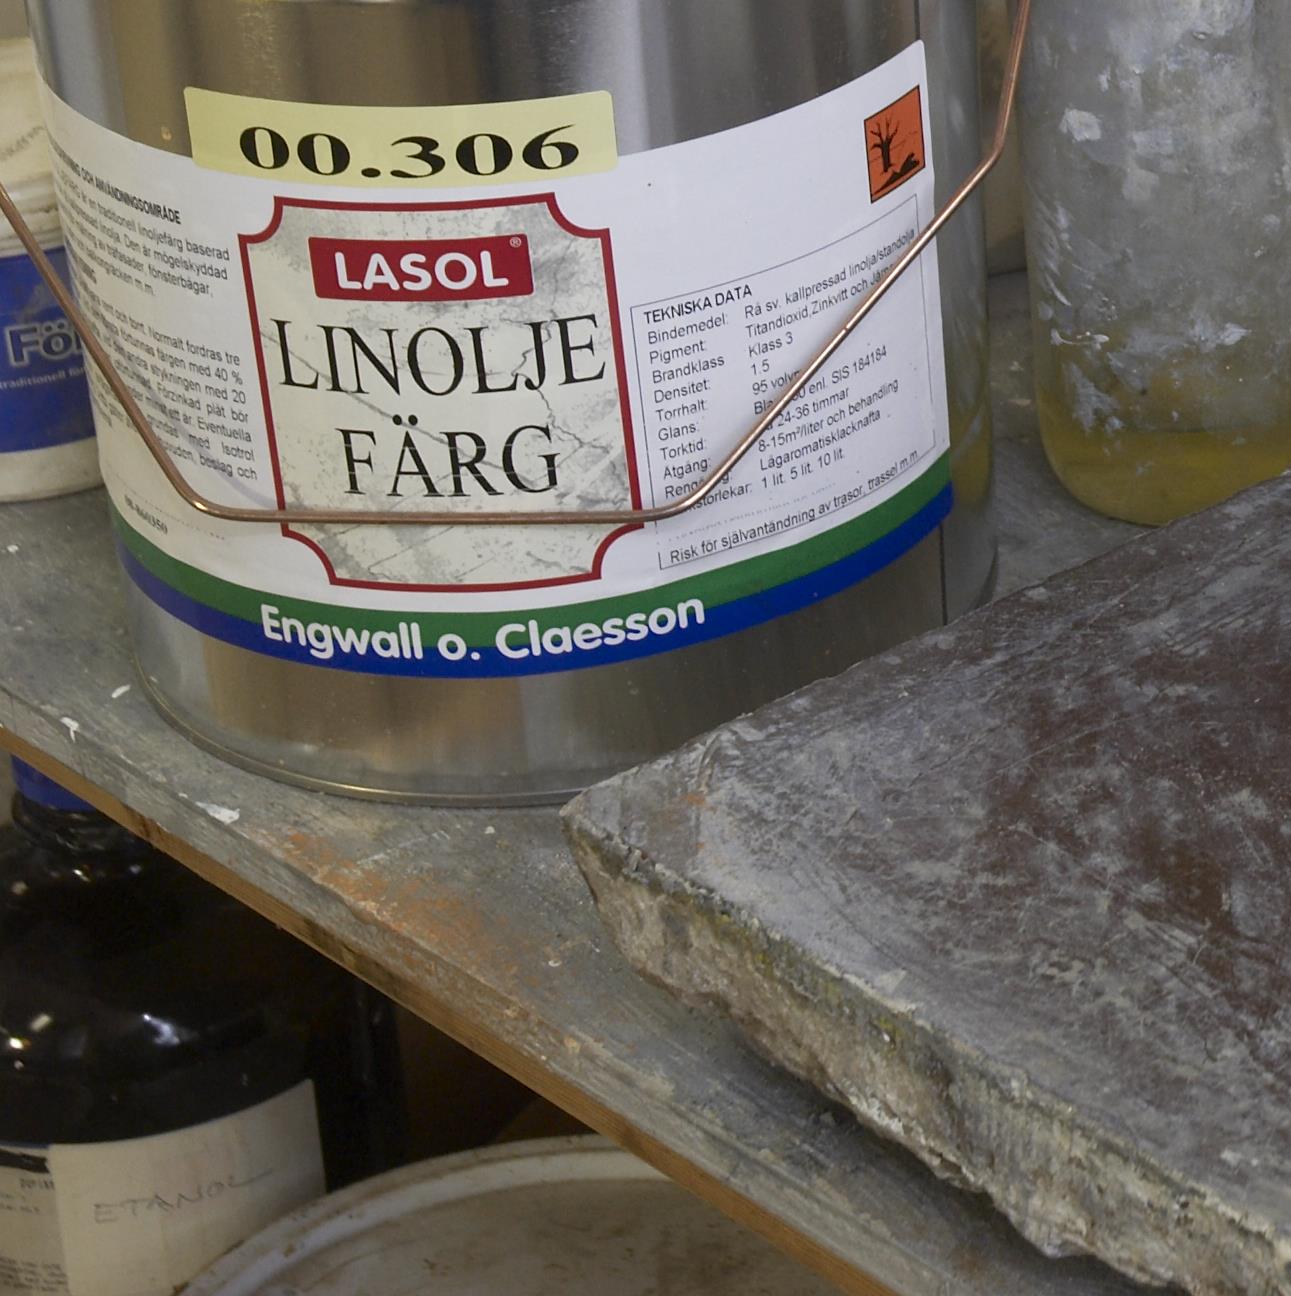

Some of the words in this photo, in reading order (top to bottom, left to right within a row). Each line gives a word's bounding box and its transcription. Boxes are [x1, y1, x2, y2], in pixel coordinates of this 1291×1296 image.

[240, 124, 578, 178] 00.306
[138, 221, 183, 252] linoljefärg
[185, 238, 230, 261] baserad
[153, 250, 227, 280] mögelskyddad
[335, 250, 509, 290] LASOL
[644, 296, 712, 325] TEKNISKA
[715, 284, 752, 306] DATA
[648, 314, 728, 345] Bindemedel:
[785, 271, 847, 305] kallpressad
[650, 340, 706, 364] Pigment:
[850, 282, 868, 297] och
[186, 340, 223, 361] fordras
[225, 349, 240, 366] tre
[189, 359, 211, 378] med
[215, 366, 228, 381] 40
[232, 370, 243, 386] %
[270, 314, 605, 395] LINOLJE
[652, 354, 724, 384] Brandklass
[749, 338, 782, 358] Klass
[786, 333, 793, 345] 3
[205, 384, 228, 403] med
[231, 390, 246, 404] 20
[654, 378, 711, 404] Densitet:
[656, 401, 708, 422] Torrhalt:
[752, 381, 768, 395] 95
[658, 423, 699, 441] Glans:
[831, 366, 849, 384] SIS
[853, 348, 887, 376] 184184
[827, 411, 846, 426] och
[848, 379, 899, 414] behandling
[189, 432, 210, 449] med
[198, 415, 251, 443] Eventuella
[660, 439, 707, 460] Torktid:
[812, 388, 849, 414] timmar
[237, 467, 257, 480] och
[336, 414, 560, 497] FÄRG
[762, 477, 767, 490] 1
[790, 466, 798, 479] 5
[817, 454, 831, 468] 10
[670, 545, 697, 564] Risk
[701, 537, 717, 553] för
[721, 509, 815, 549] självantändning
[819, 499, 831, 514] av
[867, 465, 898, 490] trassel
[260, 604, 423, 660] Engwall
[438, 634, 480, 661] o.
[496, 598, 705, 659] Claesson
